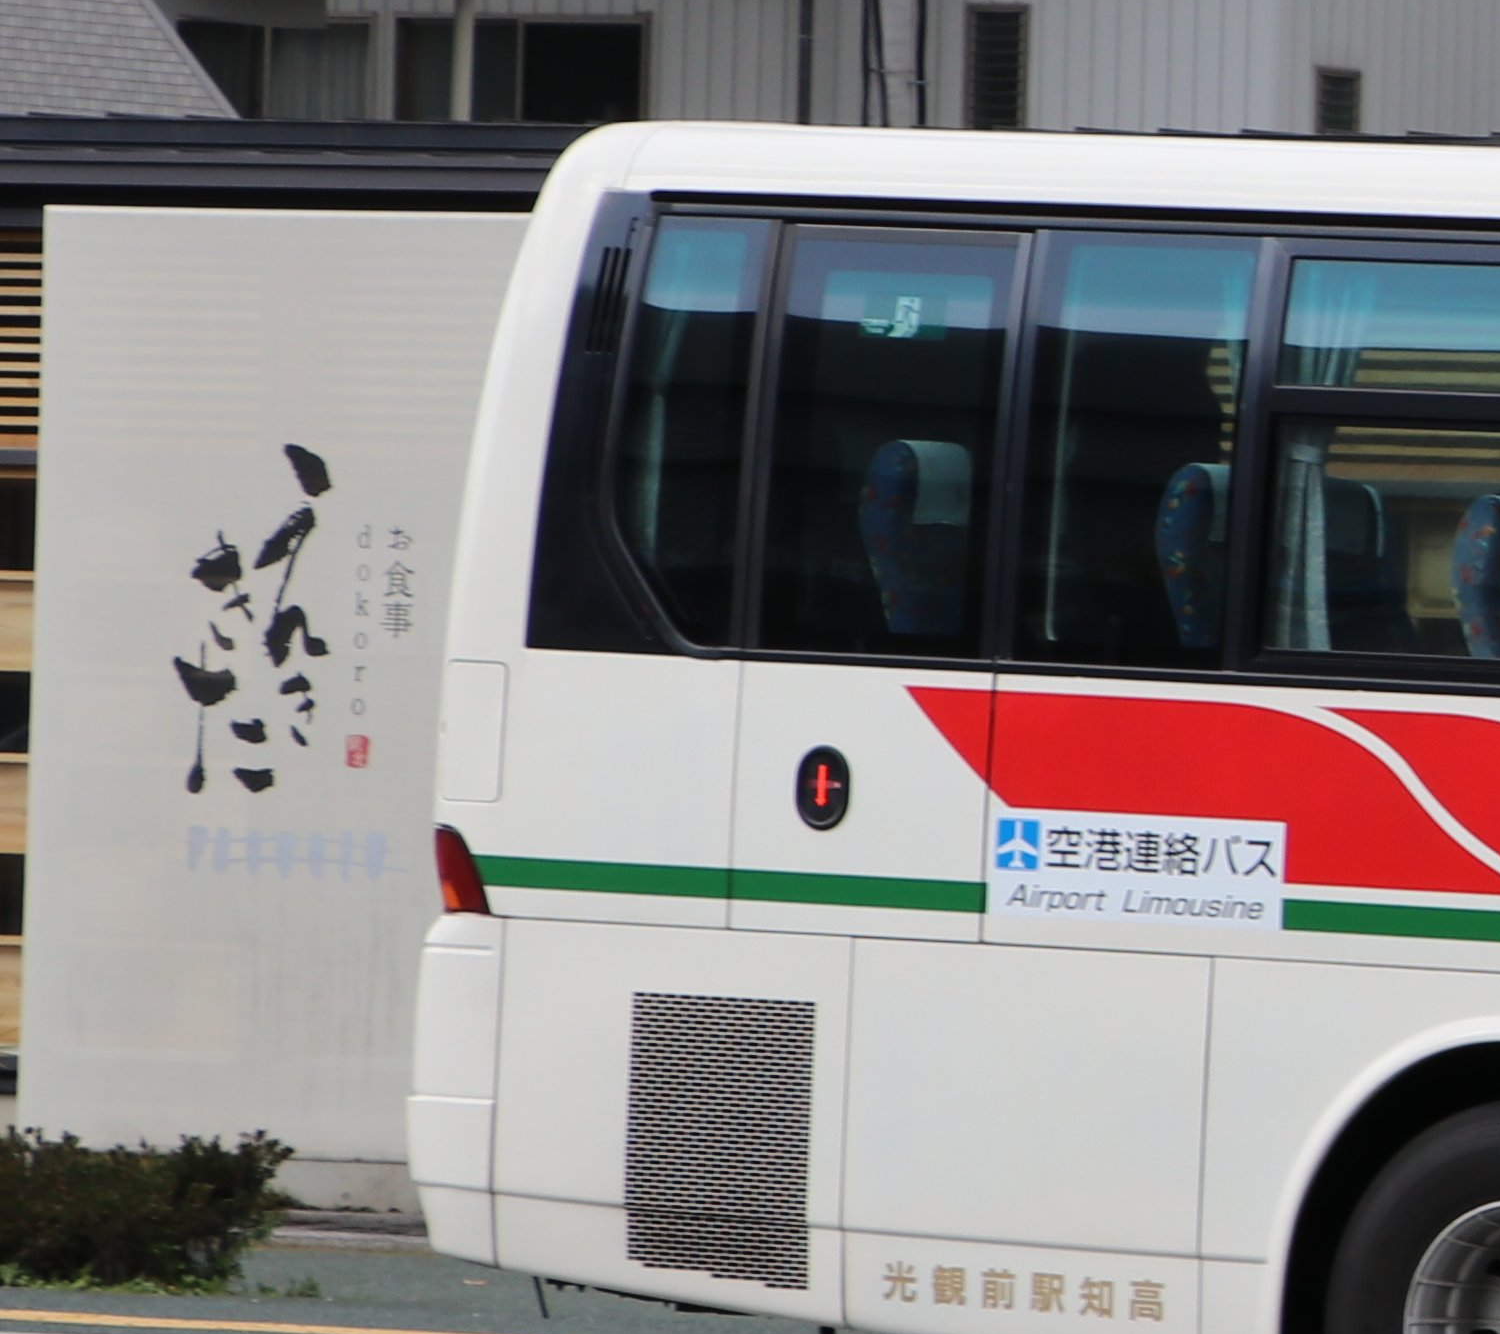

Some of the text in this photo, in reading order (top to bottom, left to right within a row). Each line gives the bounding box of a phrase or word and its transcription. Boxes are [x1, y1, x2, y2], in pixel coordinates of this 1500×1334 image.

[352, 524, 373, 716] dokoro
[380, 526, 416, 639] お食事
[1045, 825, 1278, 878] 空港連絡バス
[1007, 883, 1264, 921] Airport Limousine
